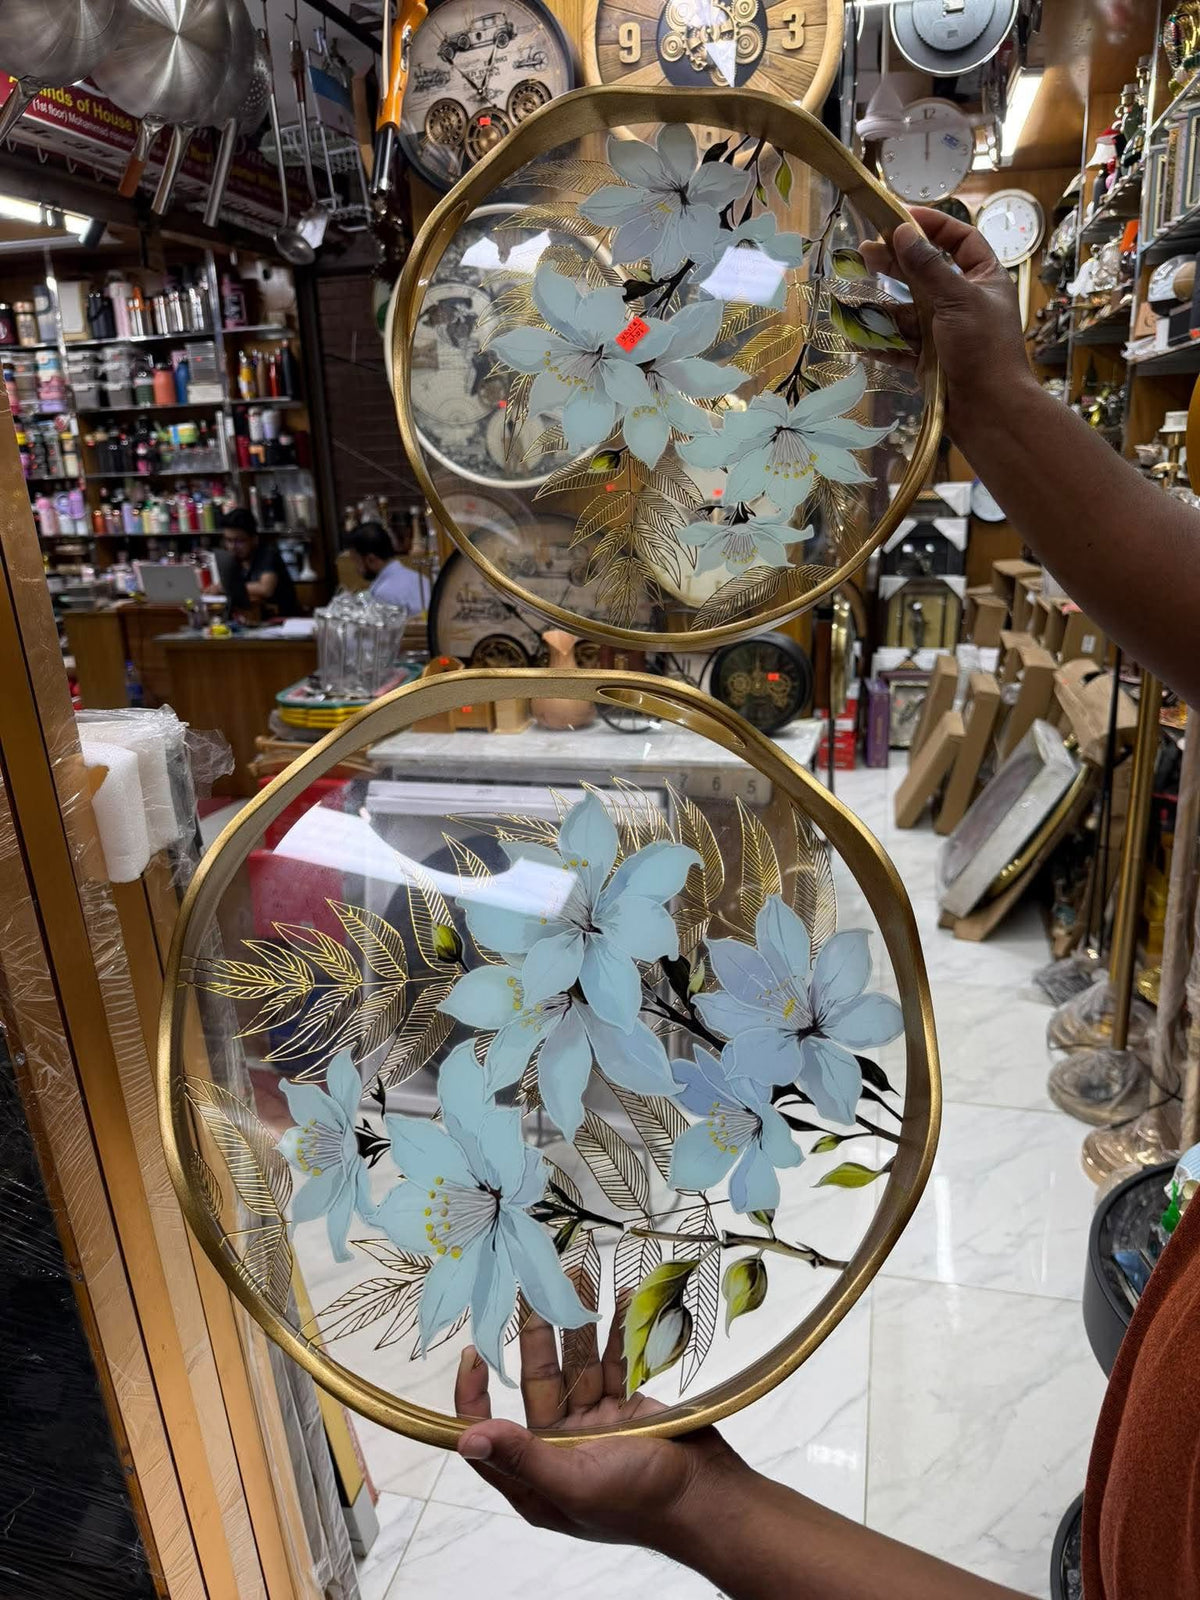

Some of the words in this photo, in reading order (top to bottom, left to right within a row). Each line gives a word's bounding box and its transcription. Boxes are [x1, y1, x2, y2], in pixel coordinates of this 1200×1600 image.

[618, 22, 641, 63] 9
[781, 9, 805, 49] 3
[76, 99, 89, 114] of
[92, 101, 132, 131] House
[711, 775, 721, 791] 6
[746, 779, 757, 795] 5
